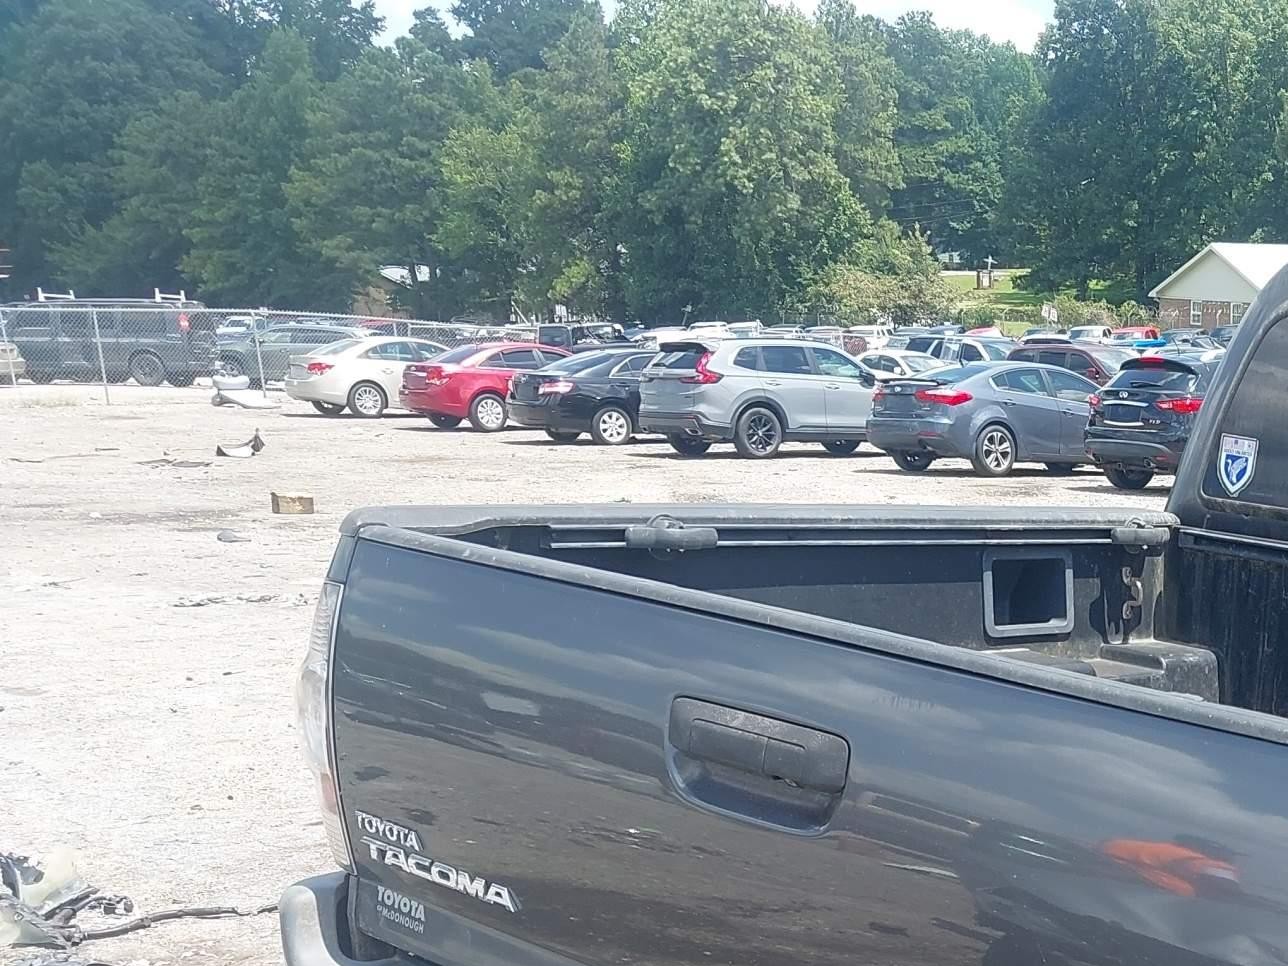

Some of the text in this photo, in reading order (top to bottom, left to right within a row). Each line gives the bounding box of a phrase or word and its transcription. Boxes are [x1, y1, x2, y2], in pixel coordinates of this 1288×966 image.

[355, 810, 424, 851] TOYOTA
[360, 836, 521, 912] TACOMA
[377, 885, 425, 921] TOYOTA
